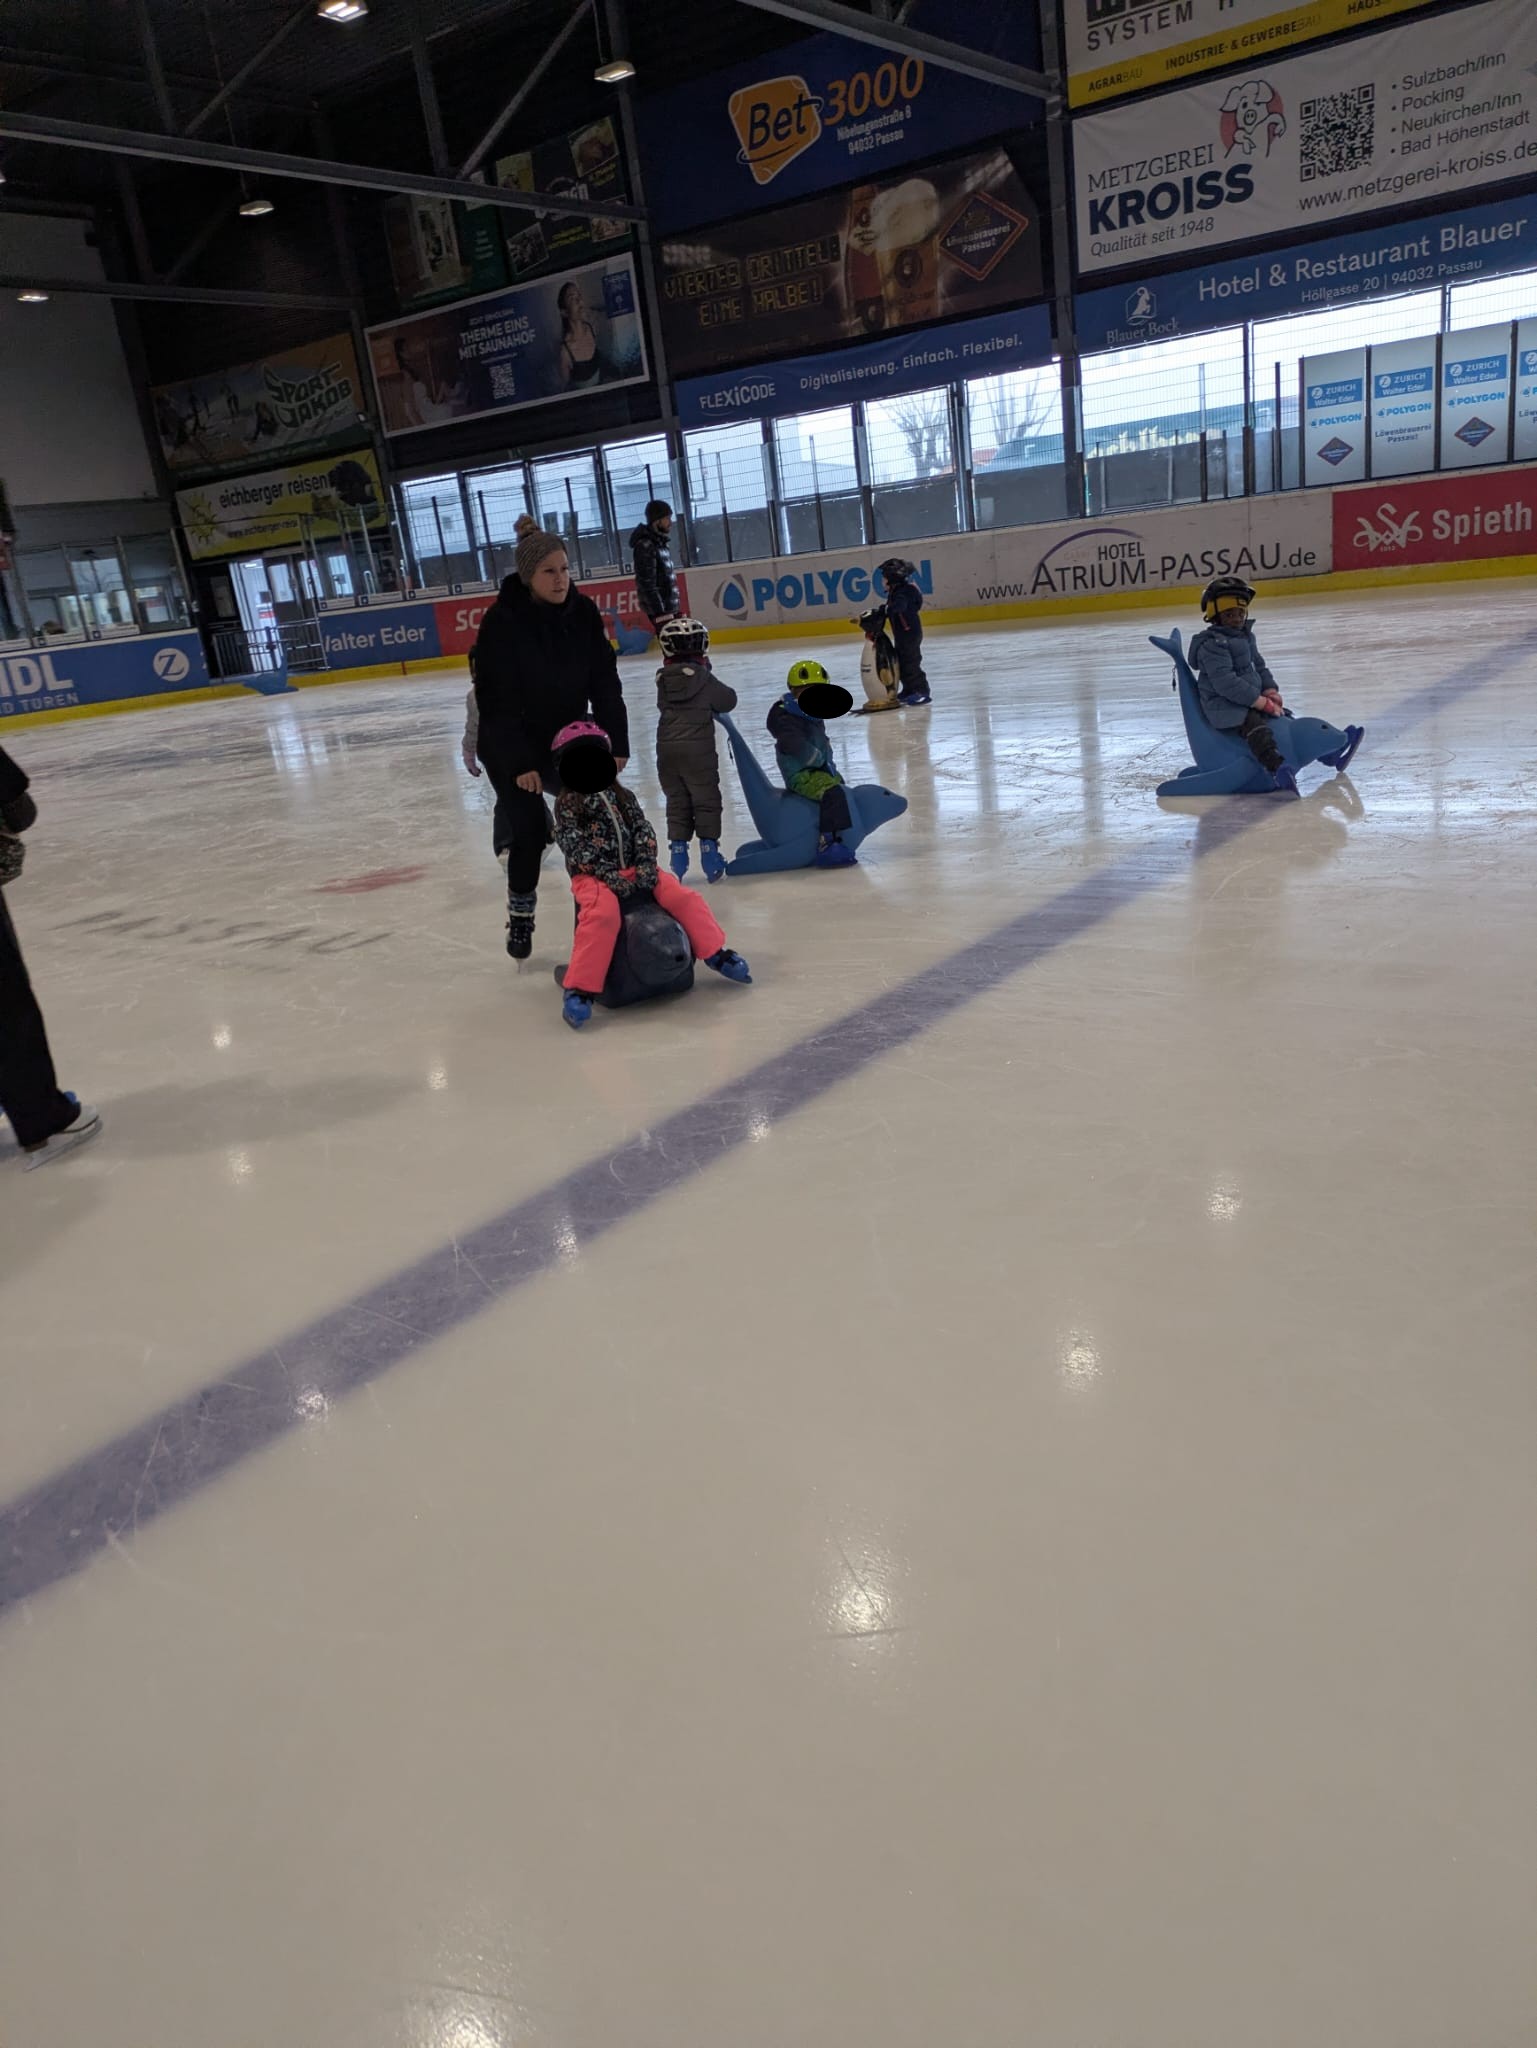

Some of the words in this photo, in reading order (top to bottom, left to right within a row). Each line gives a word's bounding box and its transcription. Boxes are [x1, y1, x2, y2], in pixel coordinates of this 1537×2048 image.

[1088, 1, 1193, 51] SYSTEM
[1089, 67, 1143, 93] AGRARBAU
[1165, 45, 1228, 71] INDUSTRIE-
[1231, 39, 1239, 50] &
[1241, 15, 1321, 48] GEWERBEBAU
[1401, 52, 1506, 91] Sulzbach/Inn
[823, 55, 925, 126] 3000
[1401, 86, 1465, 112] Pocking
[749, 93, 810, 151] Bet
[1401, 93, 1522, 134] Neukirchen/Inn
[875, 128, 905, 147] Passau
[1401, 136, 1431, 156] Bad
[1437, 111, 1531, 147] Höhenstadt
[1088, 143, 1215, 193] METZGEREI
[1299, 140, 1537, 211] www.metzgerei-kroiss.de
[1089, 163, 1254, 235] KROISS
[1090, 232, 1147, 257] Qualität
[1151, 227, 1175, 245] seit
[1179, 217, 1215, 238] 1948
[1199, 267, 1260, 302] Hotel
[1268, 263, 1287, 287] &
[1295, 235, 1430, 282] Restaurant
[1440, 218, 1528, 253] Blauer
[1302, 283, 1359, 304] Höllgasse
[1363, 277, 1380, 290] 20
[1391, 269, 1433, 286] 94032
[1437, 259, 1483, 277] Passau
[459, 322, 504, 345] THERME
[504, 315, 529, 334] EINS
[1106, 327, 1146, 344] Blauer
[1148, 316, 1180, 337] Bock
[458, 344, 478, 361] MIT
[799, 360, 899, 391] Digitalisierung.
[903, 349, 959, 369] Einfach.
[961, 333, 1024, 358] Flexibel.
[1465, 360, 1500, 372] ZURICH
[1325, 383, 1356, 395] ZURICH
[1382, 386, 1406, 396] Walter
[1407, 383, 1425, 392] Eder
[1394, 372, 1426, 383] ZURICH
[1453, 375, 1478, 385] Walter
[1479, 371, 1498, 381] Eder
[1386, 402, 1432, 417] POLYGON
[1457, 391, 1505, 406] POLYGON
[1318, 413, 1362, 427] POLYGON
[219, 482, 284, 508] eichberger
[287, 474, 328, 496] reisen
[1432, 501, 1532, 545] Spieth
[1098, 541, 1145, 561] HOTEL
[324, 632, 376, 653] alter
[380, 624, 427, 646] Eder
